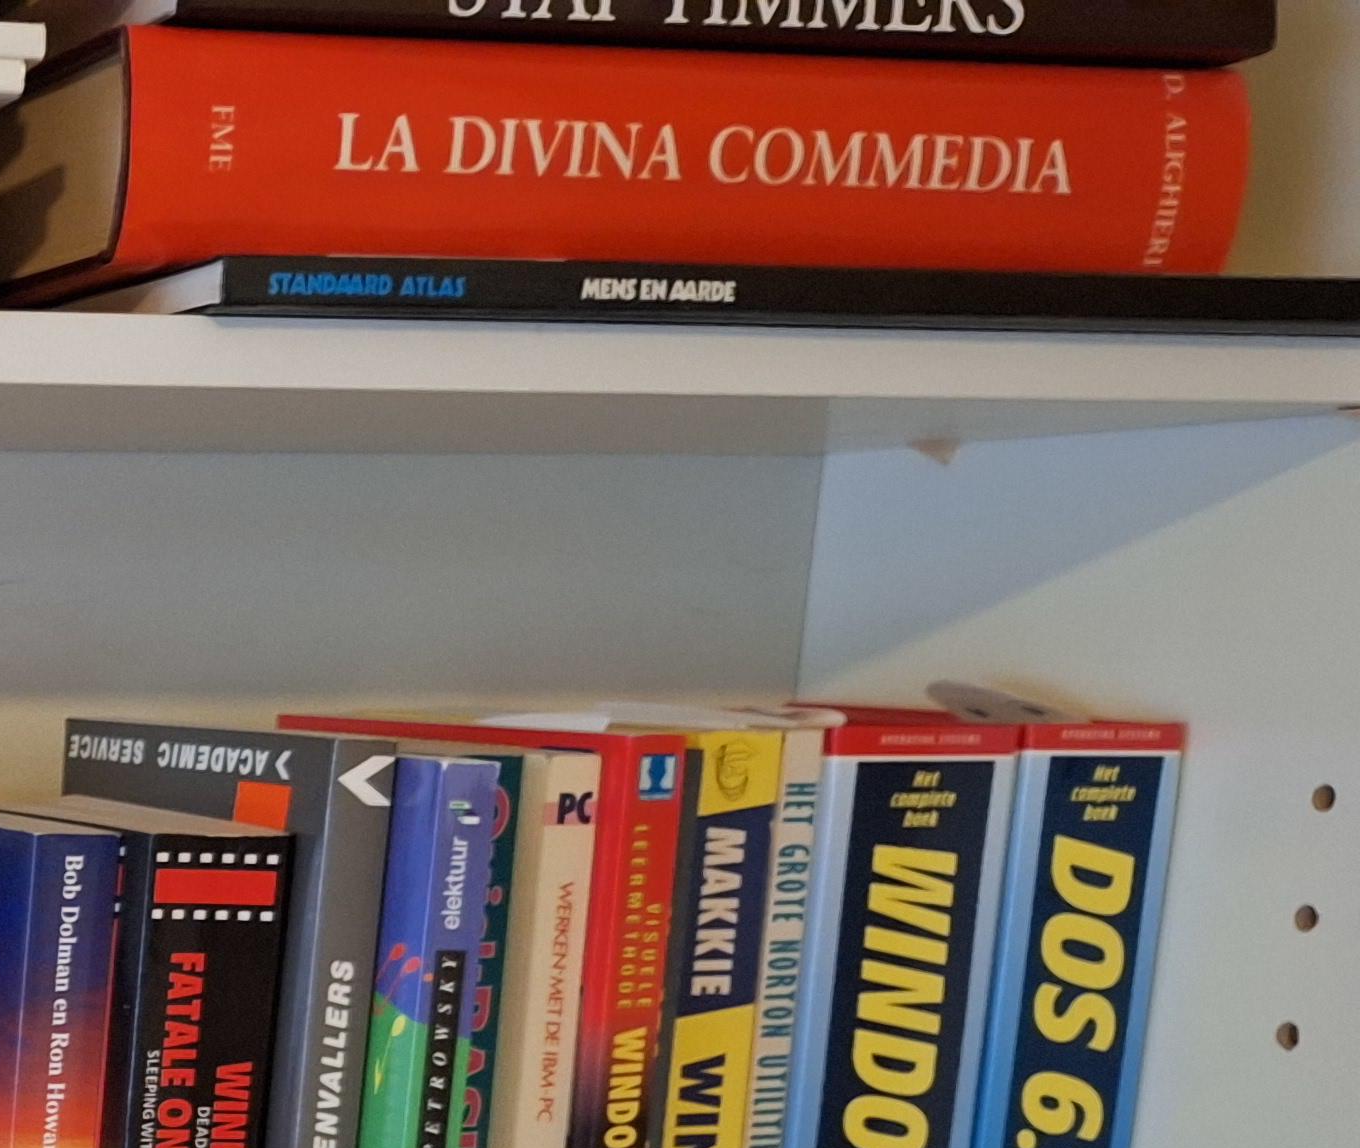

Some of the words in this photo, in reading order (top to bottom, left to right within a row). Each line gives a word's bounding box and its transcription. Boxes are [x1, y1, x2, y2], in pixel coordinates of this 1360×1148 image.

[333, 112, 420, 174] LA
[443, 115, 682, 182] DIVINA
[707, 124, 1072, 195] COMMEDIA
[399, 276, 467, 299] ATLAS
[581, 278, 638, 301] MENS
[640, 279, 668, 301] EN
[670, 280, 736, 303] AARDE
[68, 734, 145, 764] SERVICE
[157, 745, 270, 777] ACADEMIC
[555, 791, 594, 825] PC
[61, 854, 85, 900] Bob
[442, 836, 470, 931] elektuur
[769, 843, 812, 921] GROTE
[689, 825, 748, 999] MAKKIE
[53, 906, 80, 993] Dolman
[639, 903, 663, 1010] VISUELE
[1033, 834, 1136, 1054] DOS
[50, 998, 69, 1026] en
[760, 940, 805, 1039] NORTON
[160, 951, 206, 1088] FATALE
[541, 1020, 561, 1048] DE
[47, 1032, 70, 1076] Ron
[141, 1049, 161, 1121] SLEEPING
[194, 1105, 212, 1148] DEAD
